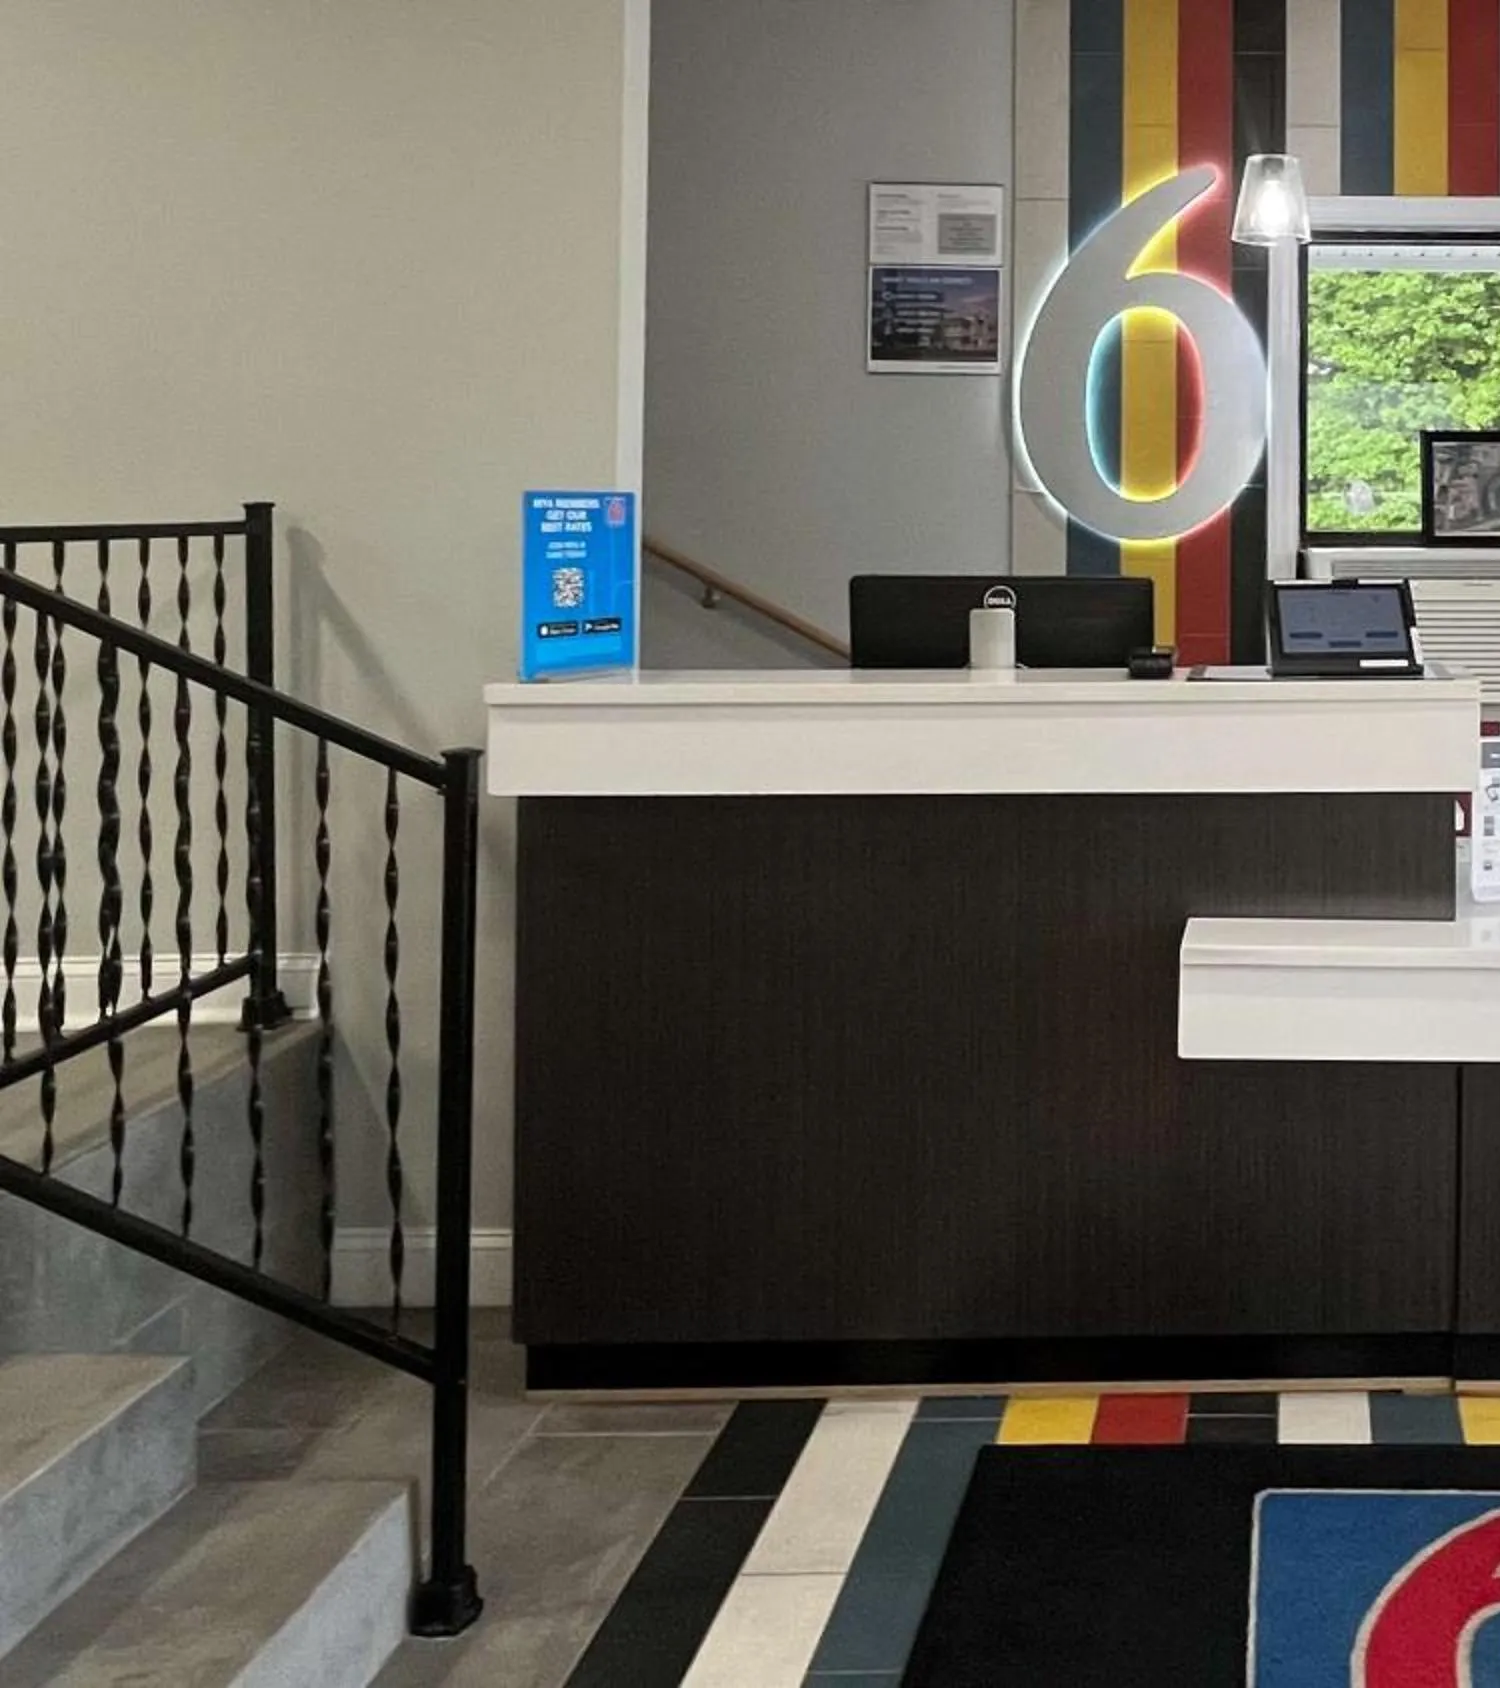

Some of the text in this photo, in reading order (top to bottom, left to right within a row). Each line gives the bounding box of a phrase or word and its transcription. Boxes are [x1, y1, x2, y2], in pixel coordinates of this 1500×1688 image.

[1017, 164, 1270, 541] 6
[545, 510, 587, 520] GET OUR
